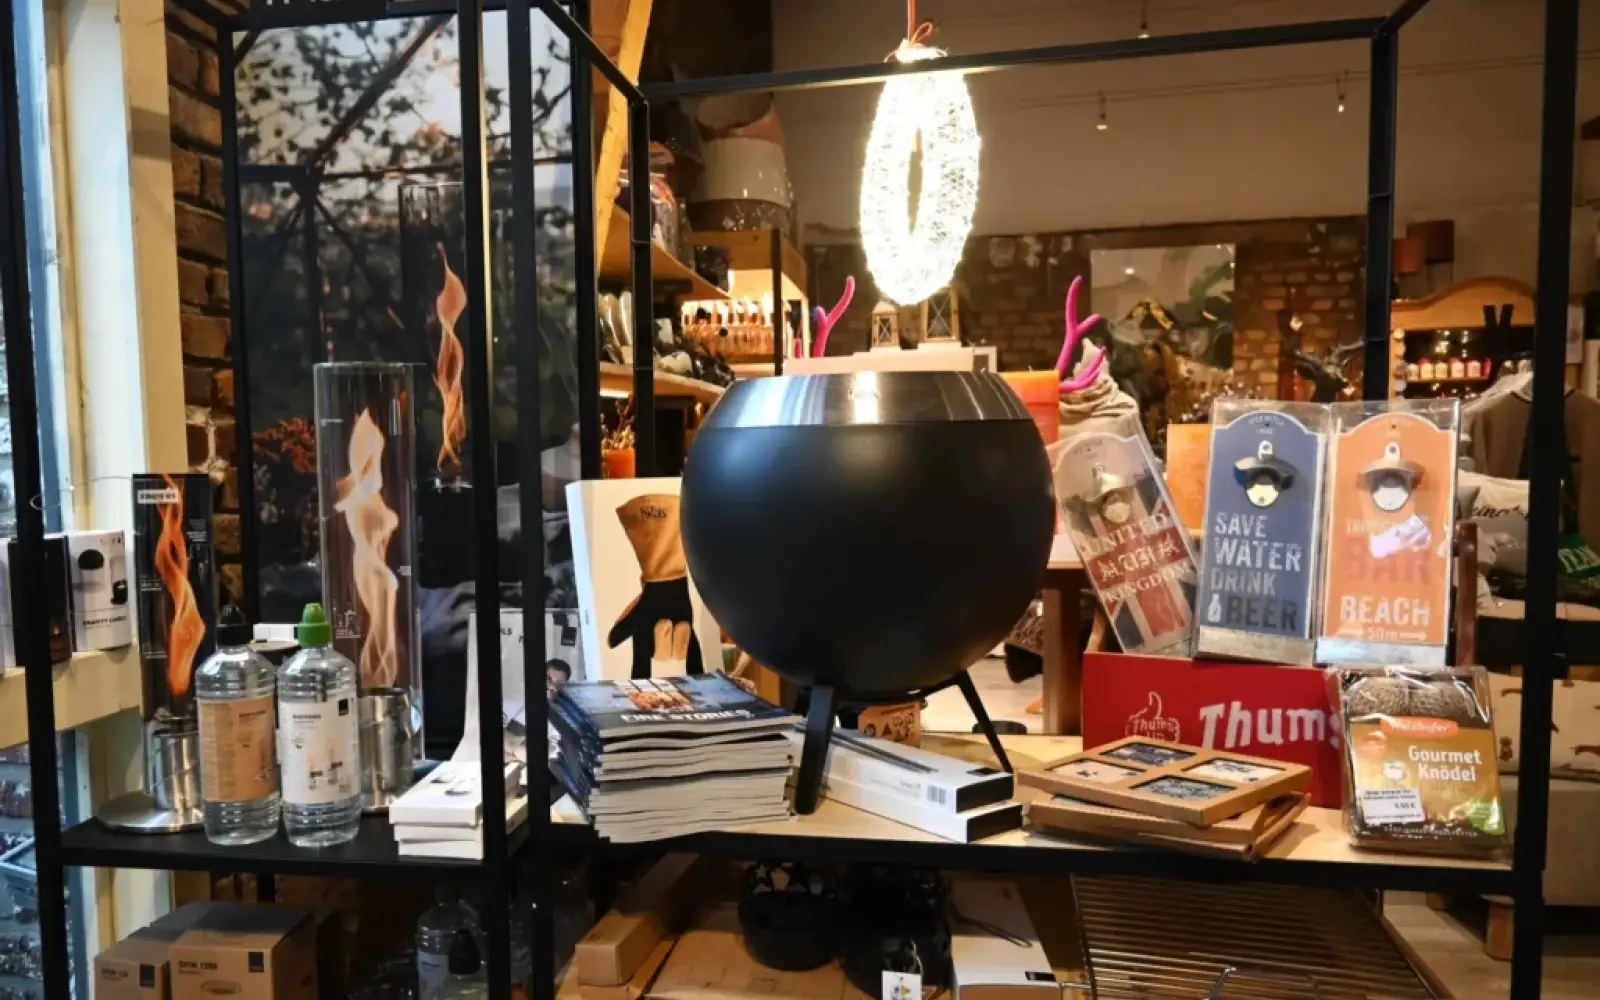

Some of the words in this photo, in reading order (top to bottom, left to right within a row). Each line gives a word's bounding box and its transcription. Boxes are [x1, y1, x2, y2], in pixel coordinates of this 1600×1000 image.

[1081, 512, 1168, 555] UNITED
[1214, 512, 1268, 538] SAVE
[1213, 537, 1303, 572] WATER
[1106, 561, 1190, 603] KINGDOM
[1210, 567, 1276, 596] DRINK
[1226, 595, 1298, 631] BEER
[1340, 595, 1430, 626] BEACH
[620, 713, 666, 722] FIRE
[1408, 745, 1482, 765] Gourmet
[1418, 763, 1477, 782] Knödel
